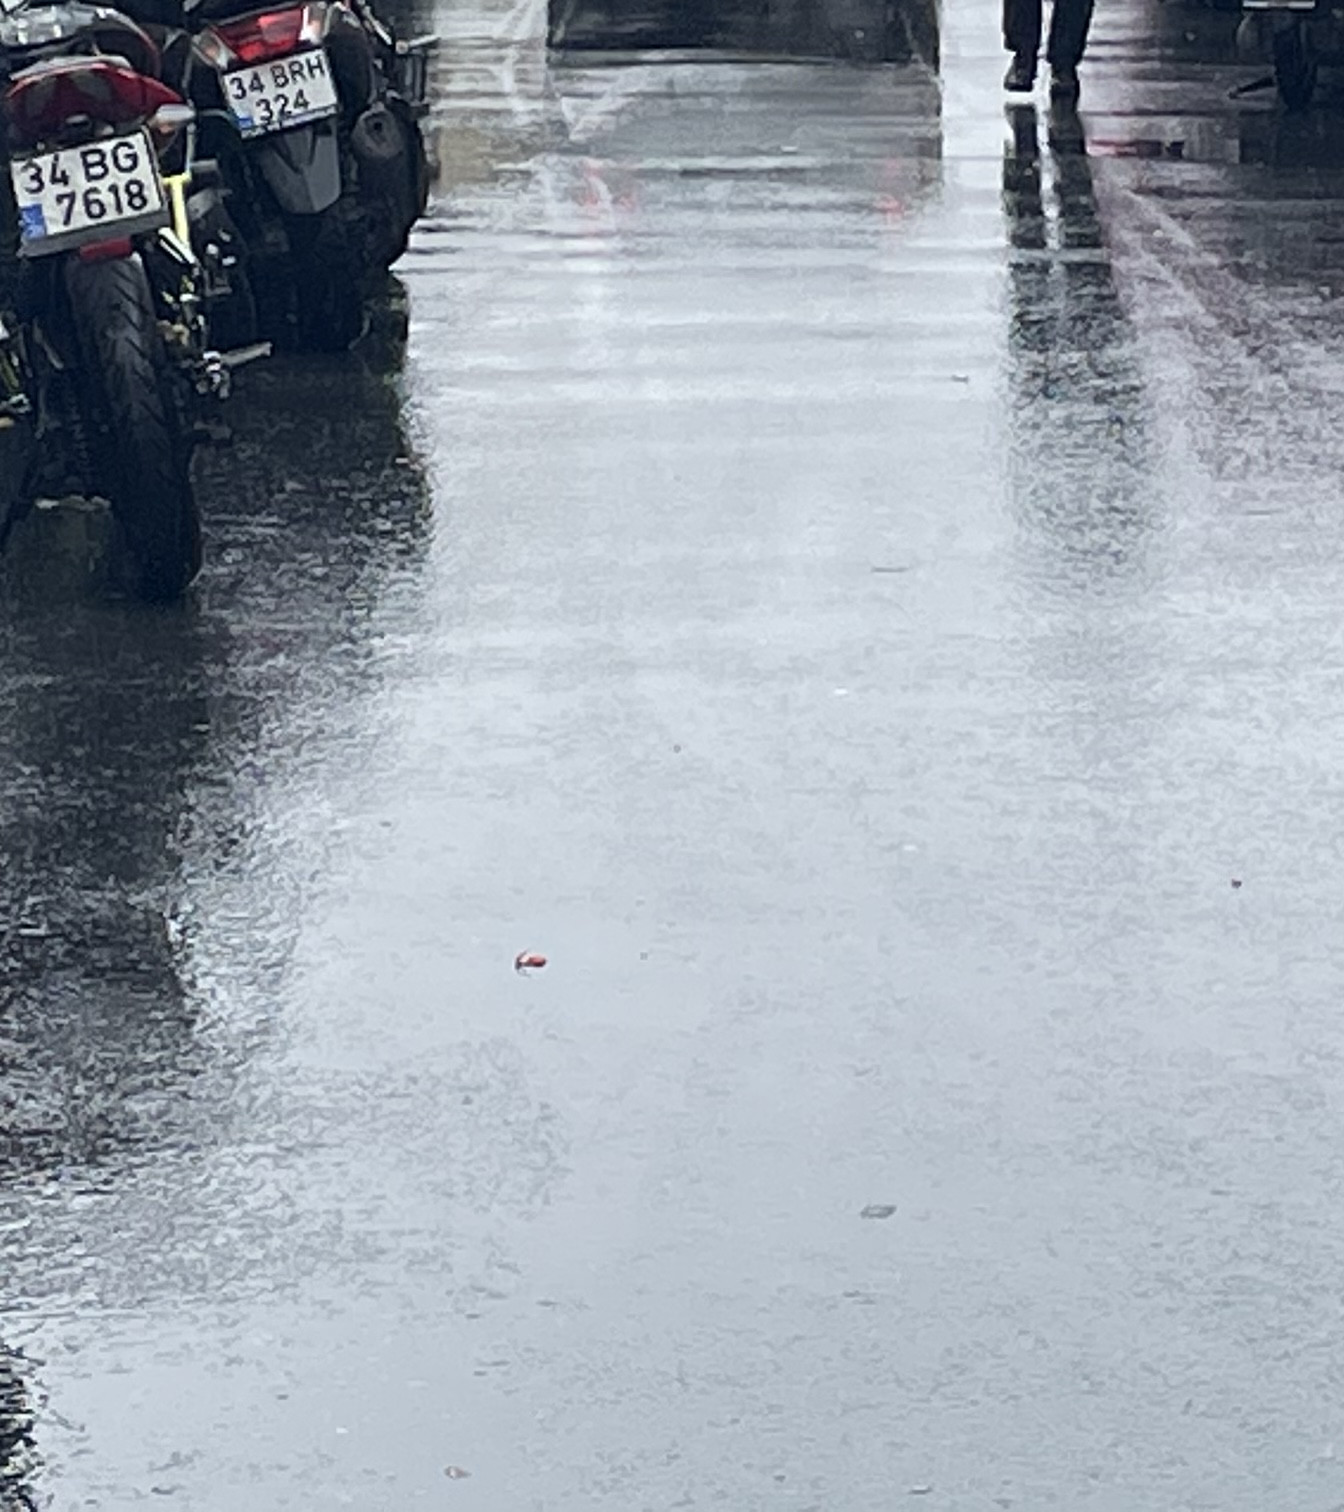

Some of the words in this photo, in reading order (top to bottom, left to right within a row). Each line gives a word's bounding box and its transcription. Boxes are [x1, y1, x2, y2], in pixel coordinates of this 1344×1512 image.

[229, 71, 265, 100] 34
[270, 54, 325, 88] BRH
[256, 88, 310, 128] 324
[20, 152, 70, 195] 34
[80, 141, 139, 183] BG
[56, 178, 148, 227] 7618
